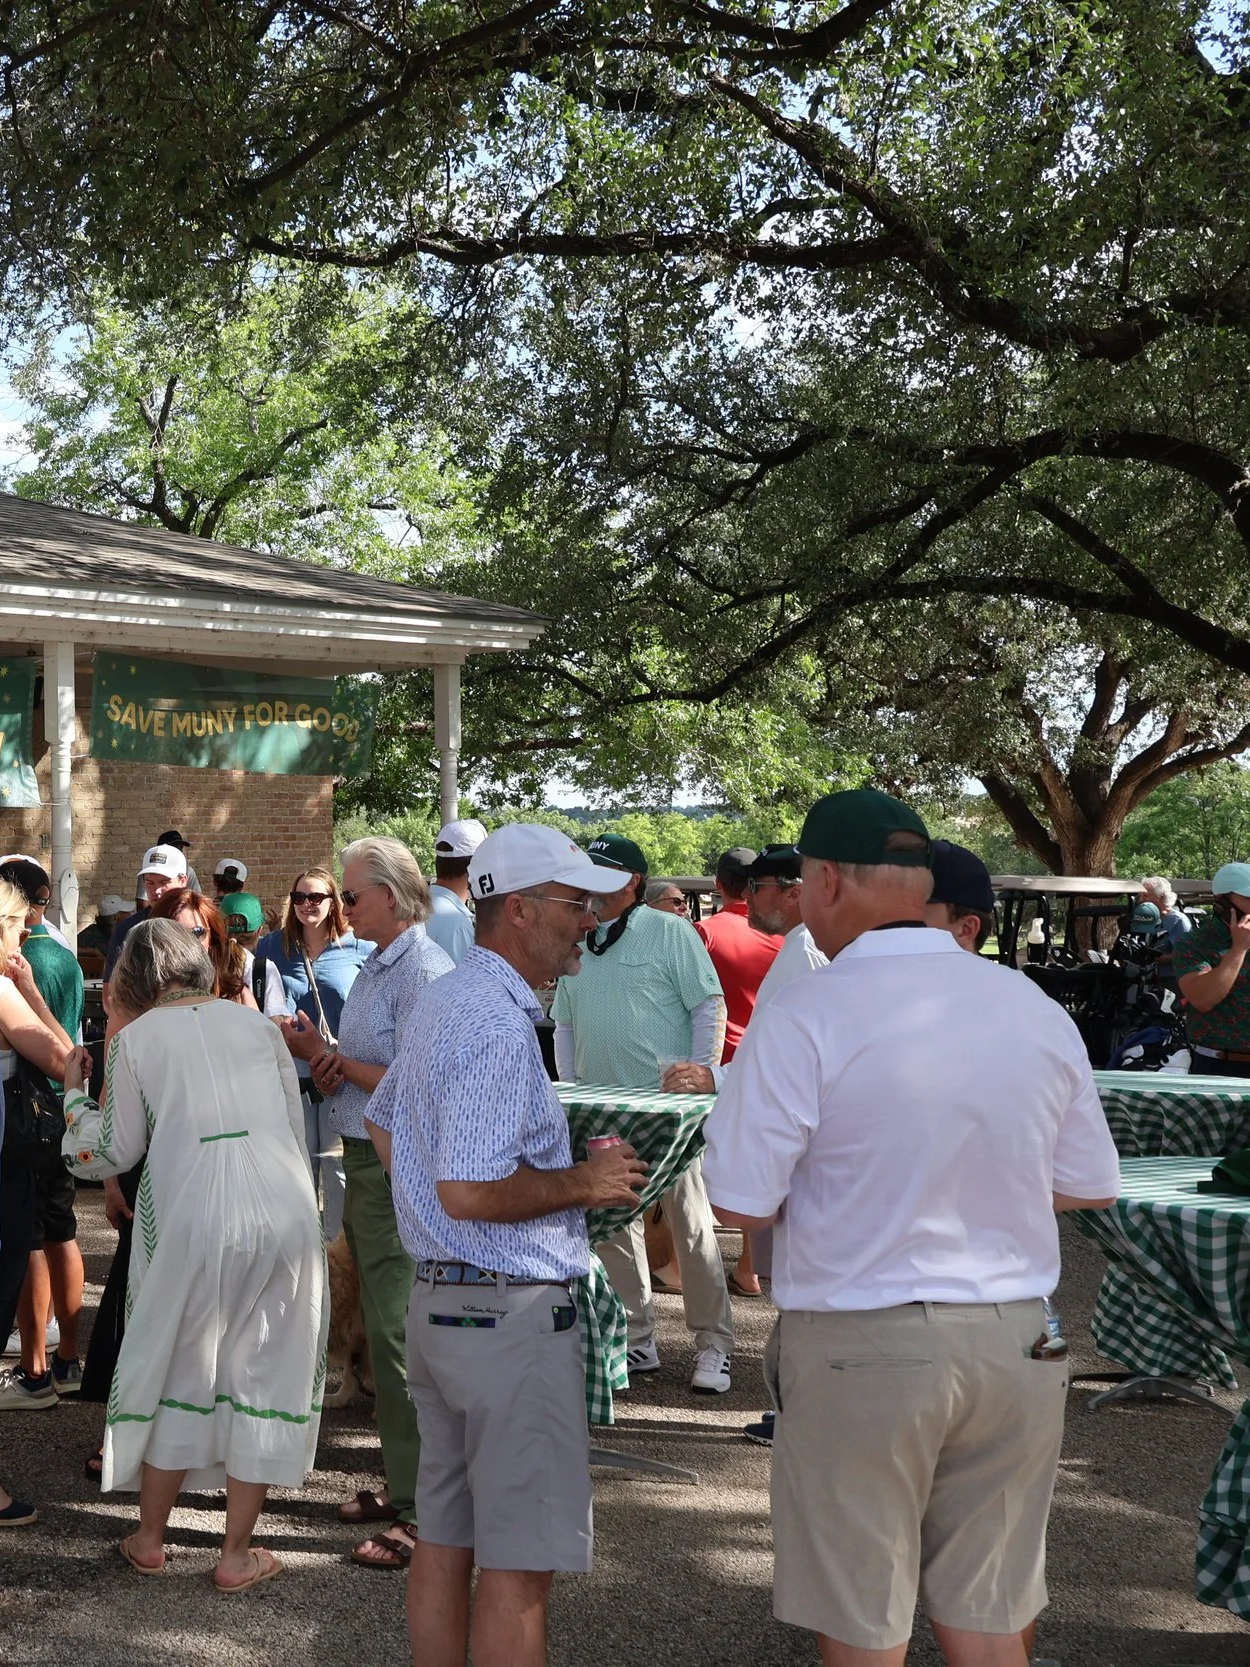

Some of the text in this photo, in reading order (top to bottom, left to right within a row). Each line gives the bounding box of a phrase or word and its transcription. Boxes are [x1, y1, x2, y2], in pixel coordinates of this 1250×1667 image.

[106, 694, 361, 743] SAVE MUNY FOR GOOD
[478, 873, 495, 895] FJ
